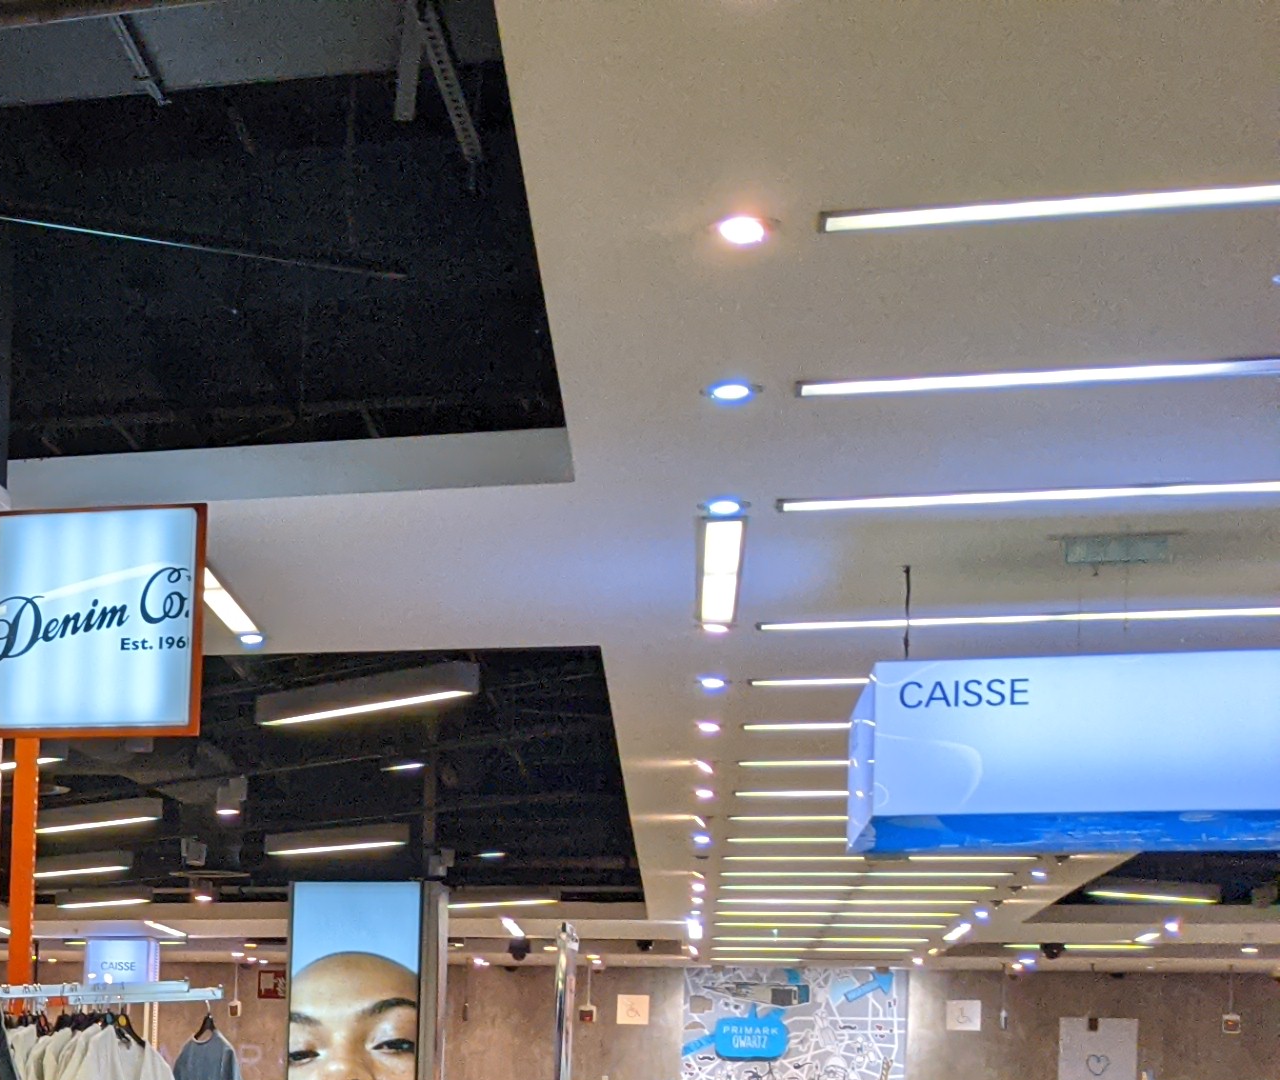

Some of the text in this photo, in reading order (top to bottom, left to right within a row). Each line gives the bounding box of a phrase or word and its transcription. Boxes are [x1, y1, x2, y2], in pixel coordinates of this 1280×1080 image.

[120, 636, 190, 651] Est. 196
[899, 677, 1030, 709] CAISSE
[100, 961, 136, 971] CAISSE
[722, 1026, 779, 1035] PRIMARK
[732, 1035, 768, 1049] QWARTZ
